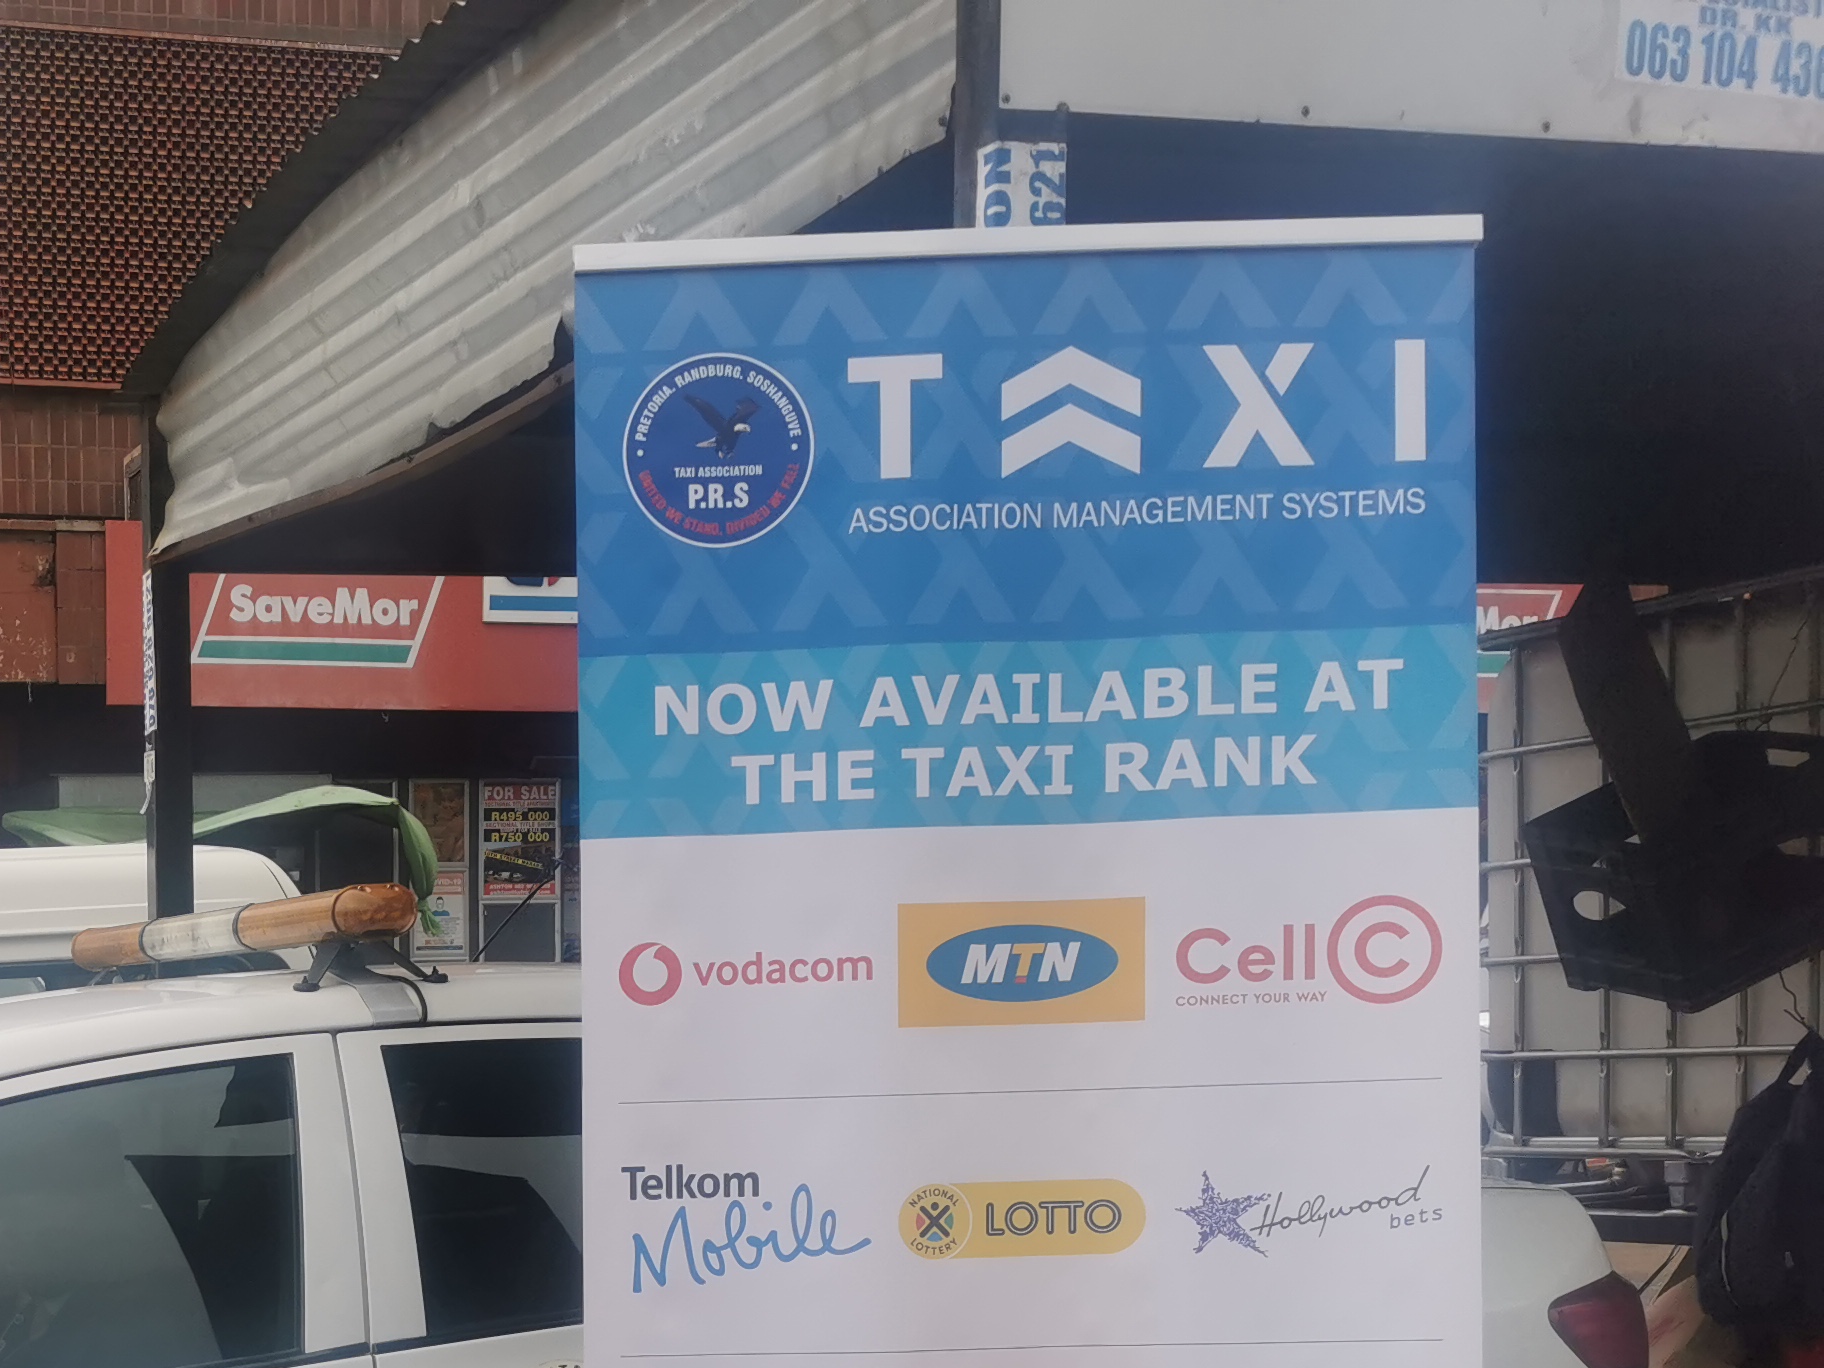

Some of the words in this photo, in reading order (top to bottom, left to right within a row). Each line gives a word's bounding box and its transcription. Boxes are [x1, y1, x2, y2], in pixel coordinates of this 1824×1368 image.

[1626, 19, 1691, 82] 063
[1701, 30, 1758, 89] 104
[746, 371, 802, 438] SOSHANGUVE
[674, 467, 696, 478] TAXI
[697, 464, 763, 478] ASSOCIATION
[688, 482, 749, 509] P.R.S
[848, 502, 1044, 535] ASSOCIATION
[1052, 493, 1274, 529] MANAGEMENT
[1282, 488, 1427, 519] SYSTEMS
[229, 584, 419, 627] SaveMor
[655, 681, 832, 737] NOW
[860, 662, 1278, 728] AVAILABLE
[1306, 658, 1404, 713] AT
[731, 751, 875, 806] THE
[902, 745, 1074, 800] TAXI
[1104, 735, 1318, 793] RANK
[484, 786, 514, 800] FOR
[521, 785, 556, 800] SALE
[491, 811, 523, 821] R495
[528, 811, 550, 821] 000
[491, 832, 523, 842] R750
[528, 832, 550, 842] 000
[692, 952, 873, 987] vodacom
[959, 939, 1080, 984] MTN
[1175, 993, 1249, 1007] CONNECT
[1253, 992, 1291, 1005] YOUR
[1296, 990, 1328, 1003] WAY
[620, 1165, 760, 1201] Telkom
[908, 1188, 960, 1208] NATIONAL
[985, 1199, 1122, 1236] LOTTO
[1250, 1165, 1430, 1238] Hollywood
[1390, 1207, 1443, 1230] bets
[632, 1183, 872, 1294] Mobile
[910, 1237, 958, 1256] LOTTERY
